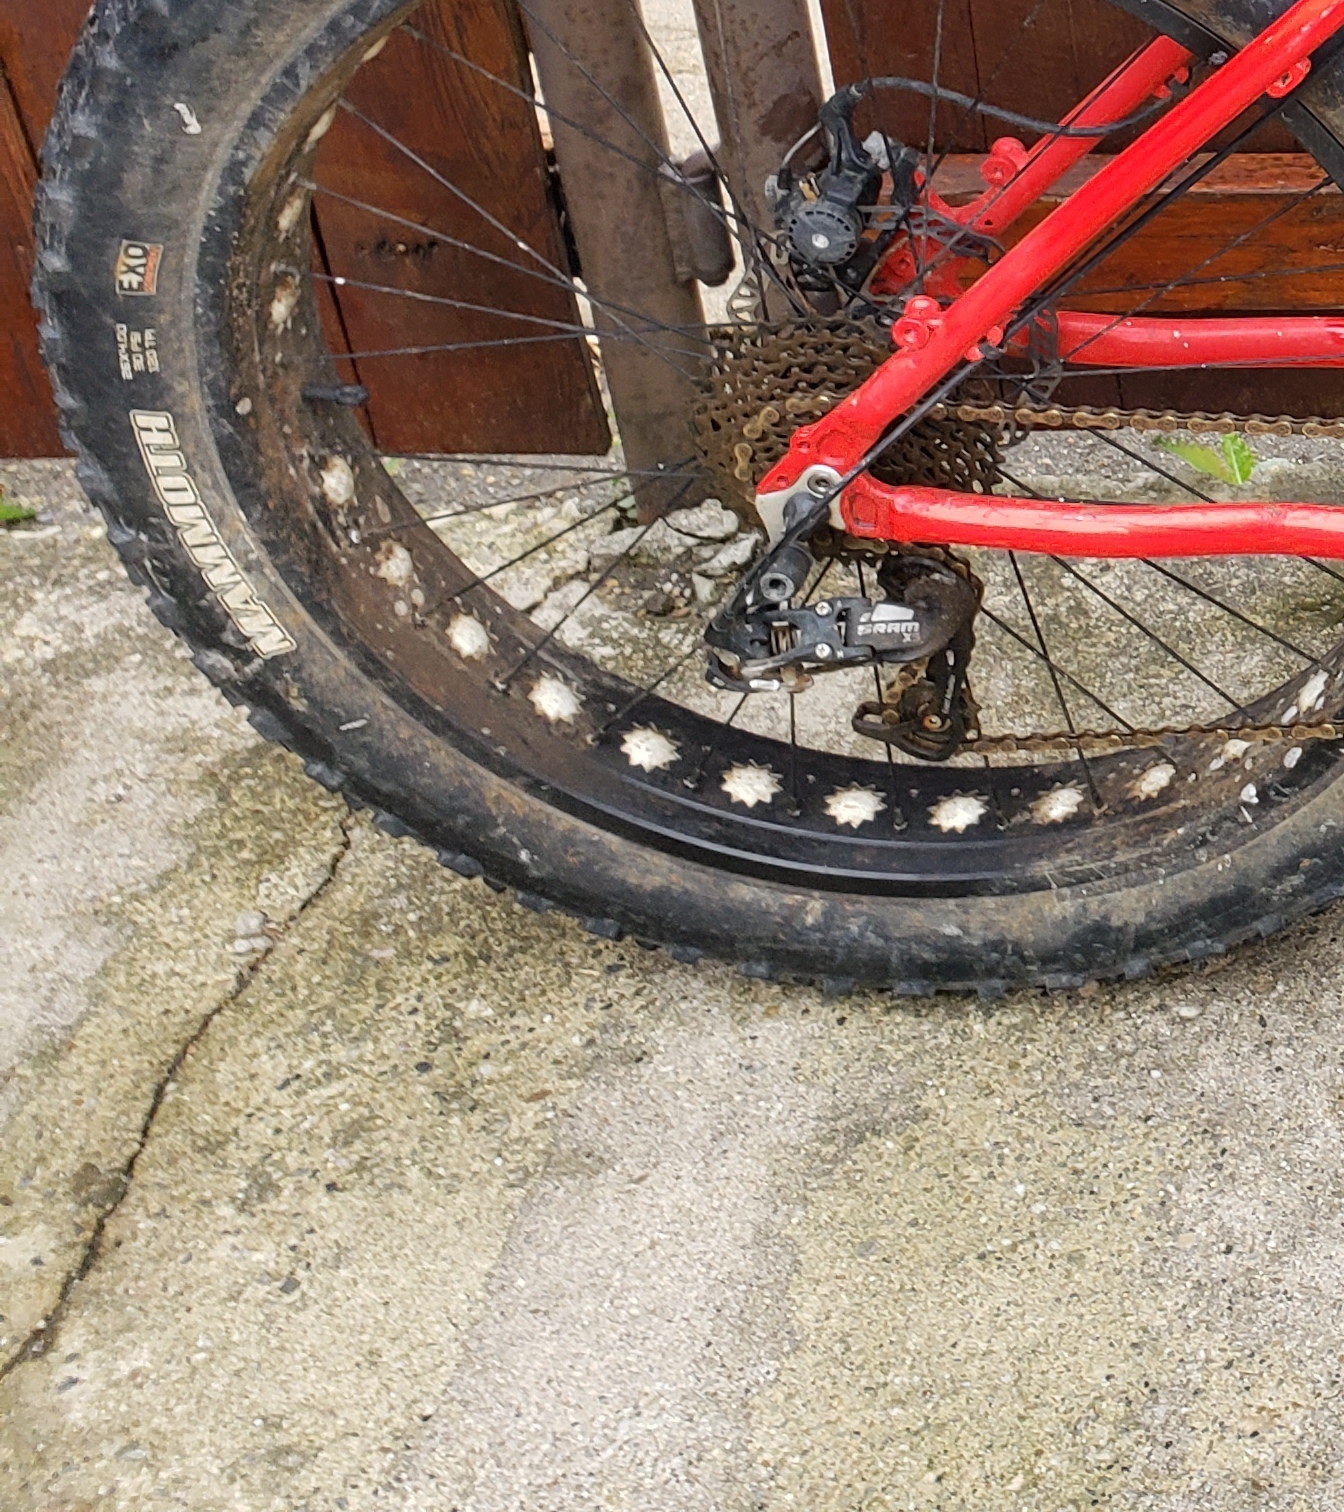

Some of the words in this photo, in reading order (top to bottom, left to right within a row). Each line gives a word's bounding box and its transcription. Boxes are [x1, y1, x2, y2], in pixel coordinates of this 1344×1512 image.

[118, 242, 149, 292] EXO
[129, 409, 298, 660] MAMMOTH
[857, 621, 920, 636] SRAM
